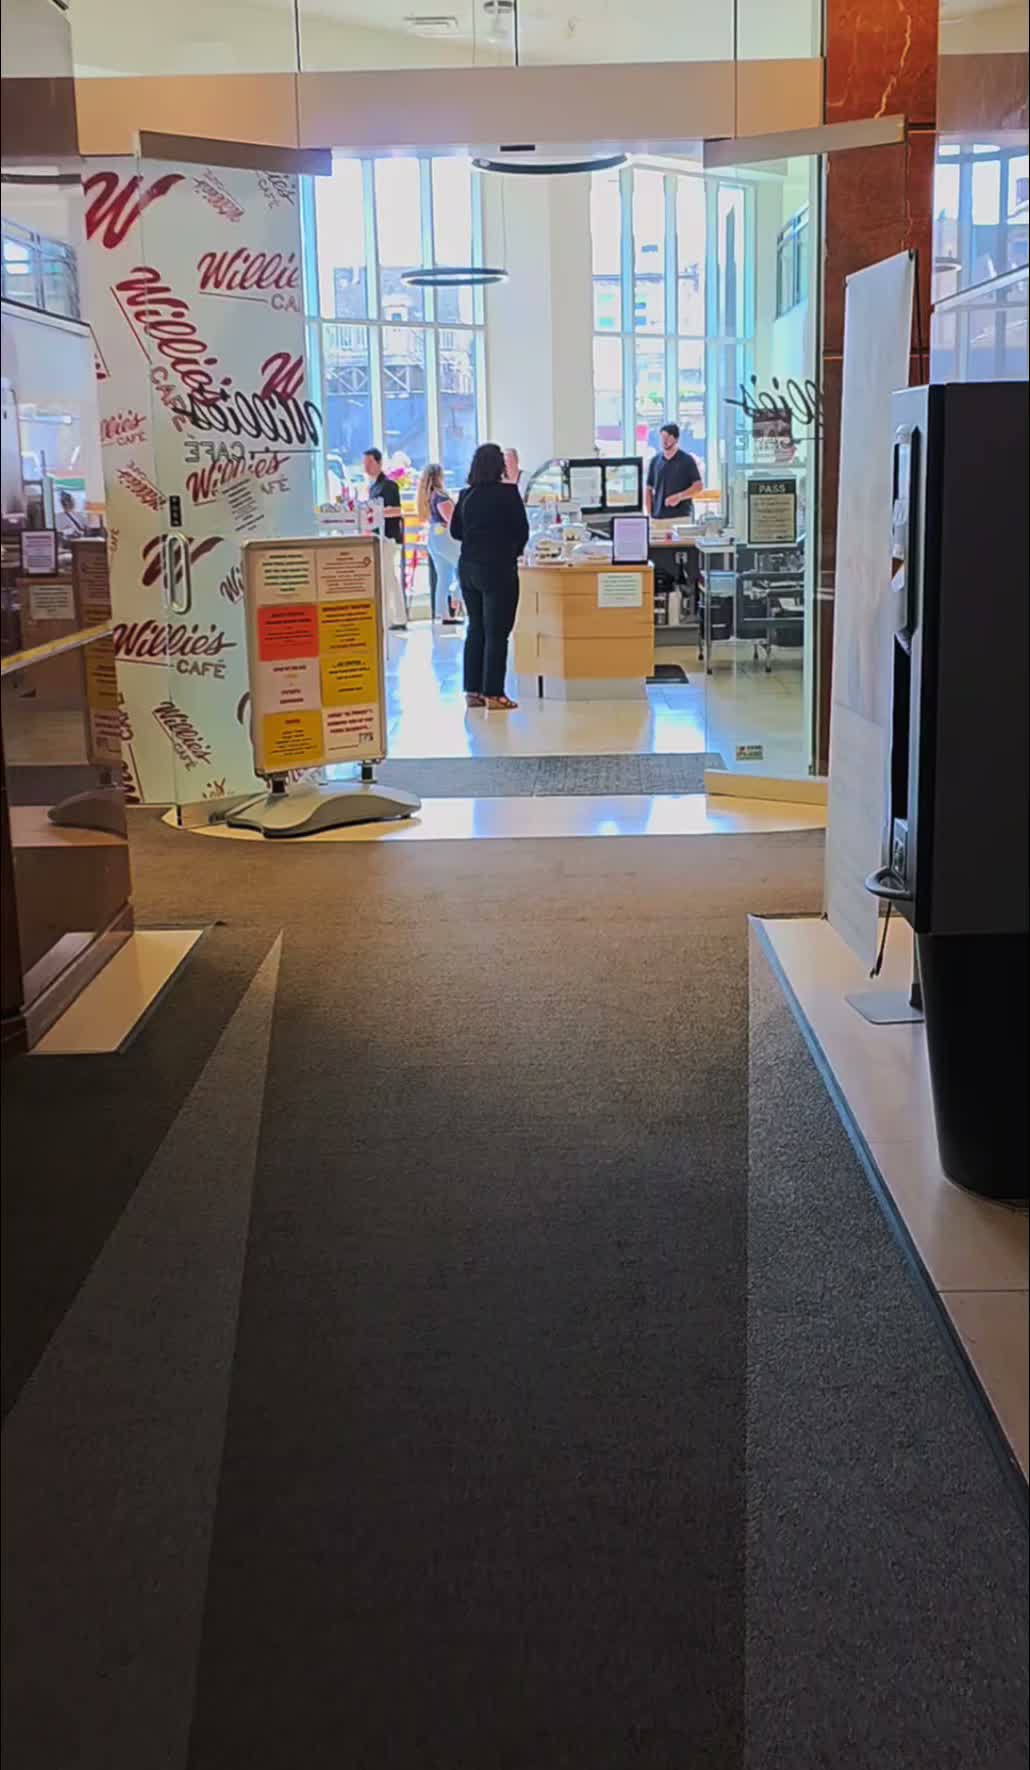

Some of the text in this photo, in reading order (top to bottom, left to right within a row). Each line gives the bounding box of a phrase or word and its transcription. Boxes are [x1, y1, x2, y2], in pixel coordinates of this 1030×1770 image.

[84, 171, 186, 249] W
[197, 248, 299, 291] Willie
[271, 295, 300, 313] CA
[758, 484, 786, 494] PASS
[112, 619, 237, 658] Willie's
[176, 658, 226, 680] CAFÉ
